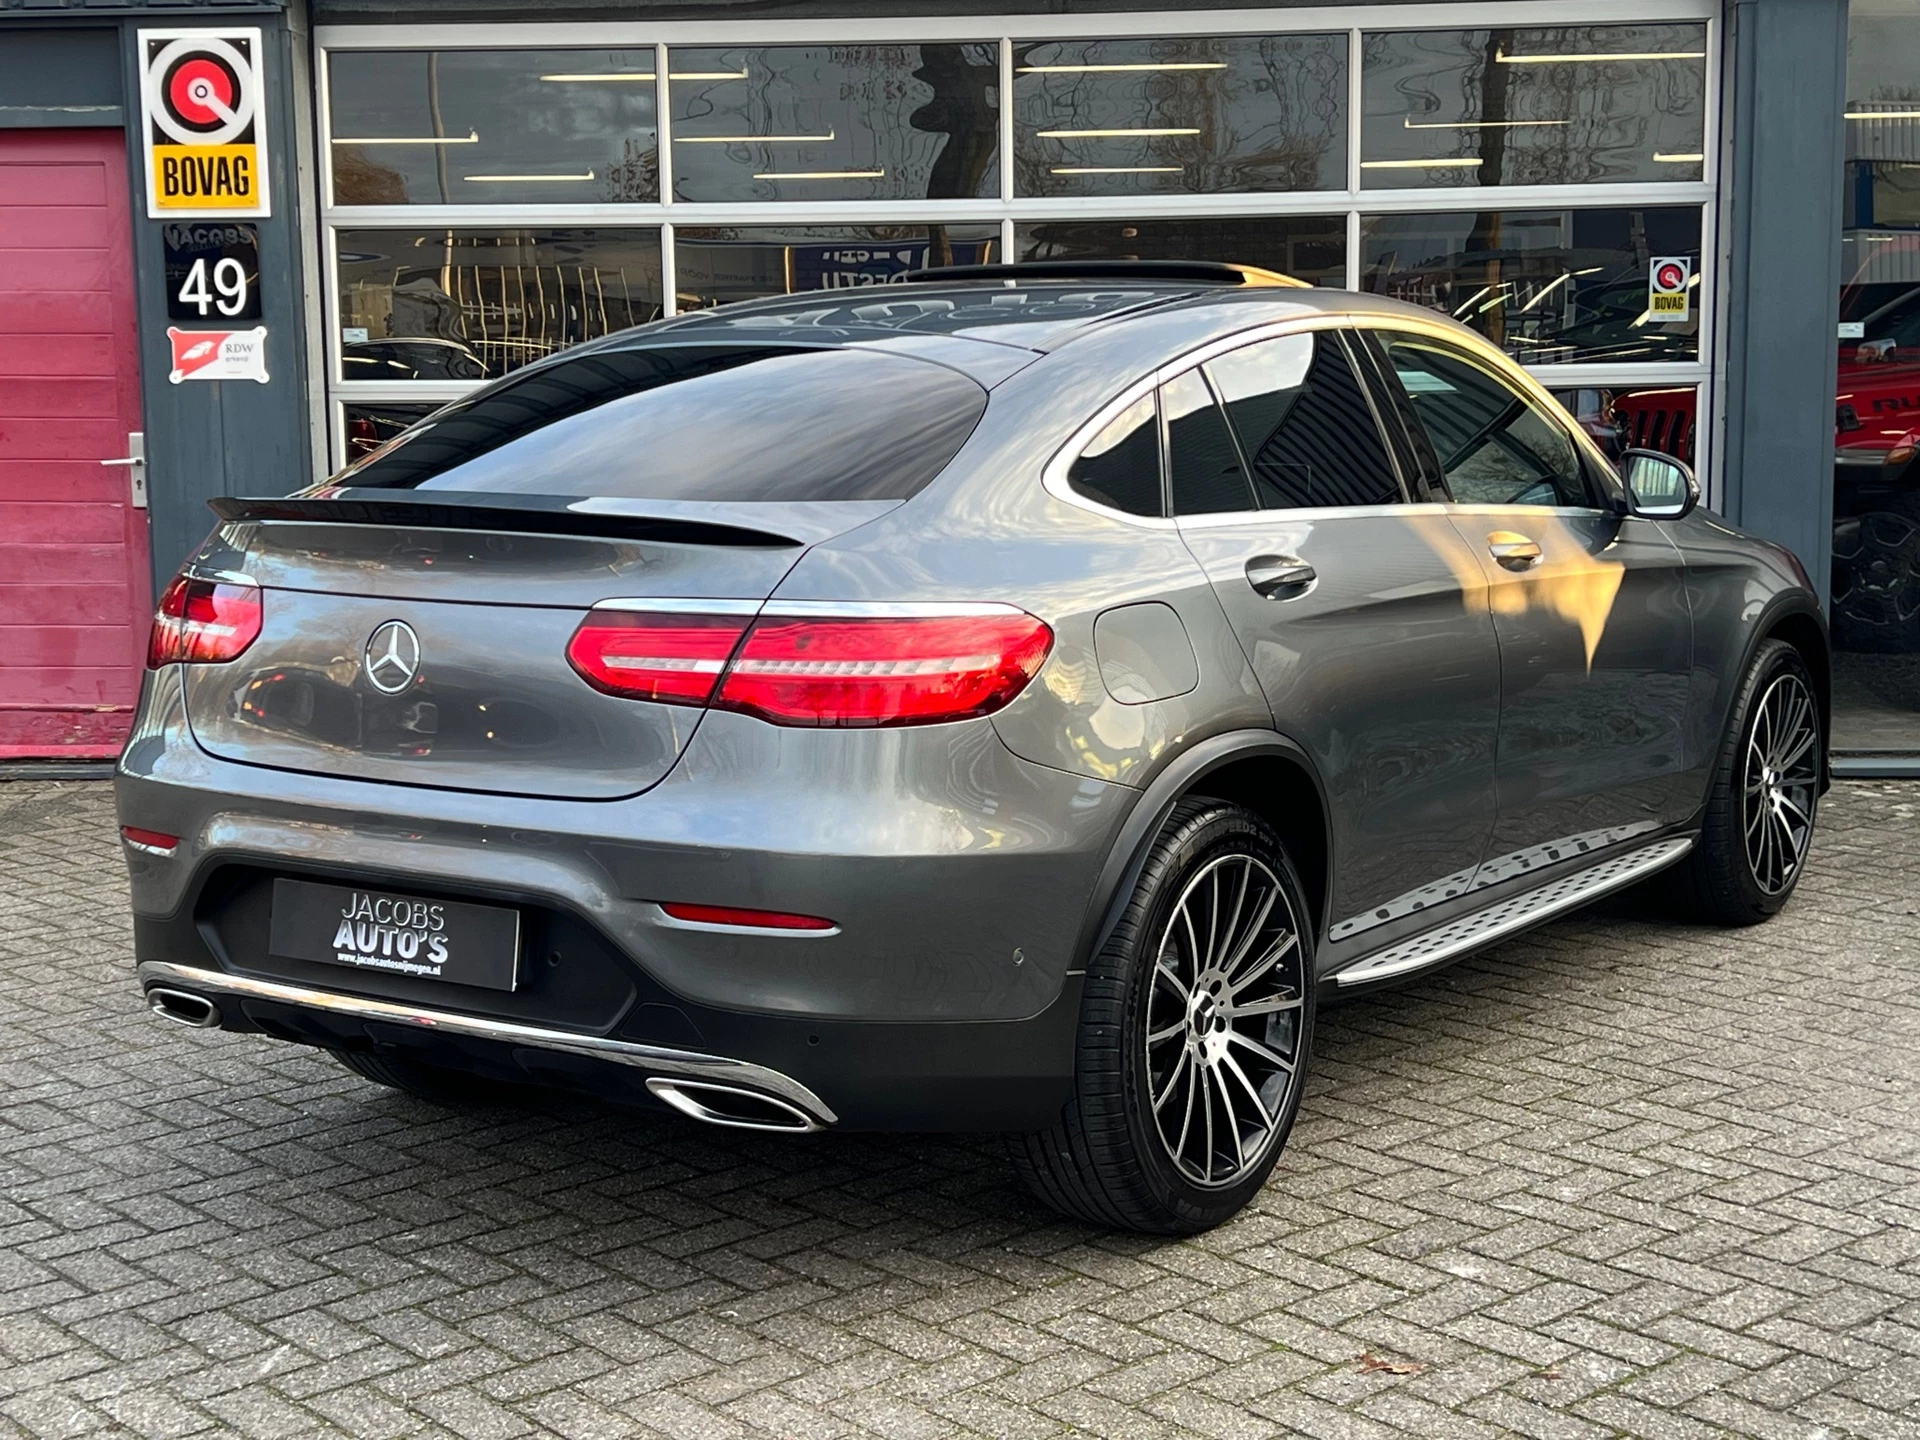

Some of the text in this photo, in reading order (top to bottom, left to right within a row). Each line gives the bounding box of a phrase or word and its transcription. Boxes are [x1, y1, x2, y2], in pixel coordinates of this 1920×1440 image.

[162, 155, 250, 197] BOVAG
[178, 258, 247, 316] 49
[1655, 296, 1684, 310] BOVAG
[225, 344, 254, 353] RDW
[341, 893, 445, 931] JACOBS
[332, 919, 449, 963] AUTO'S
[337, 952, 442, 976] www.jacobsautosnijmegen.nl
